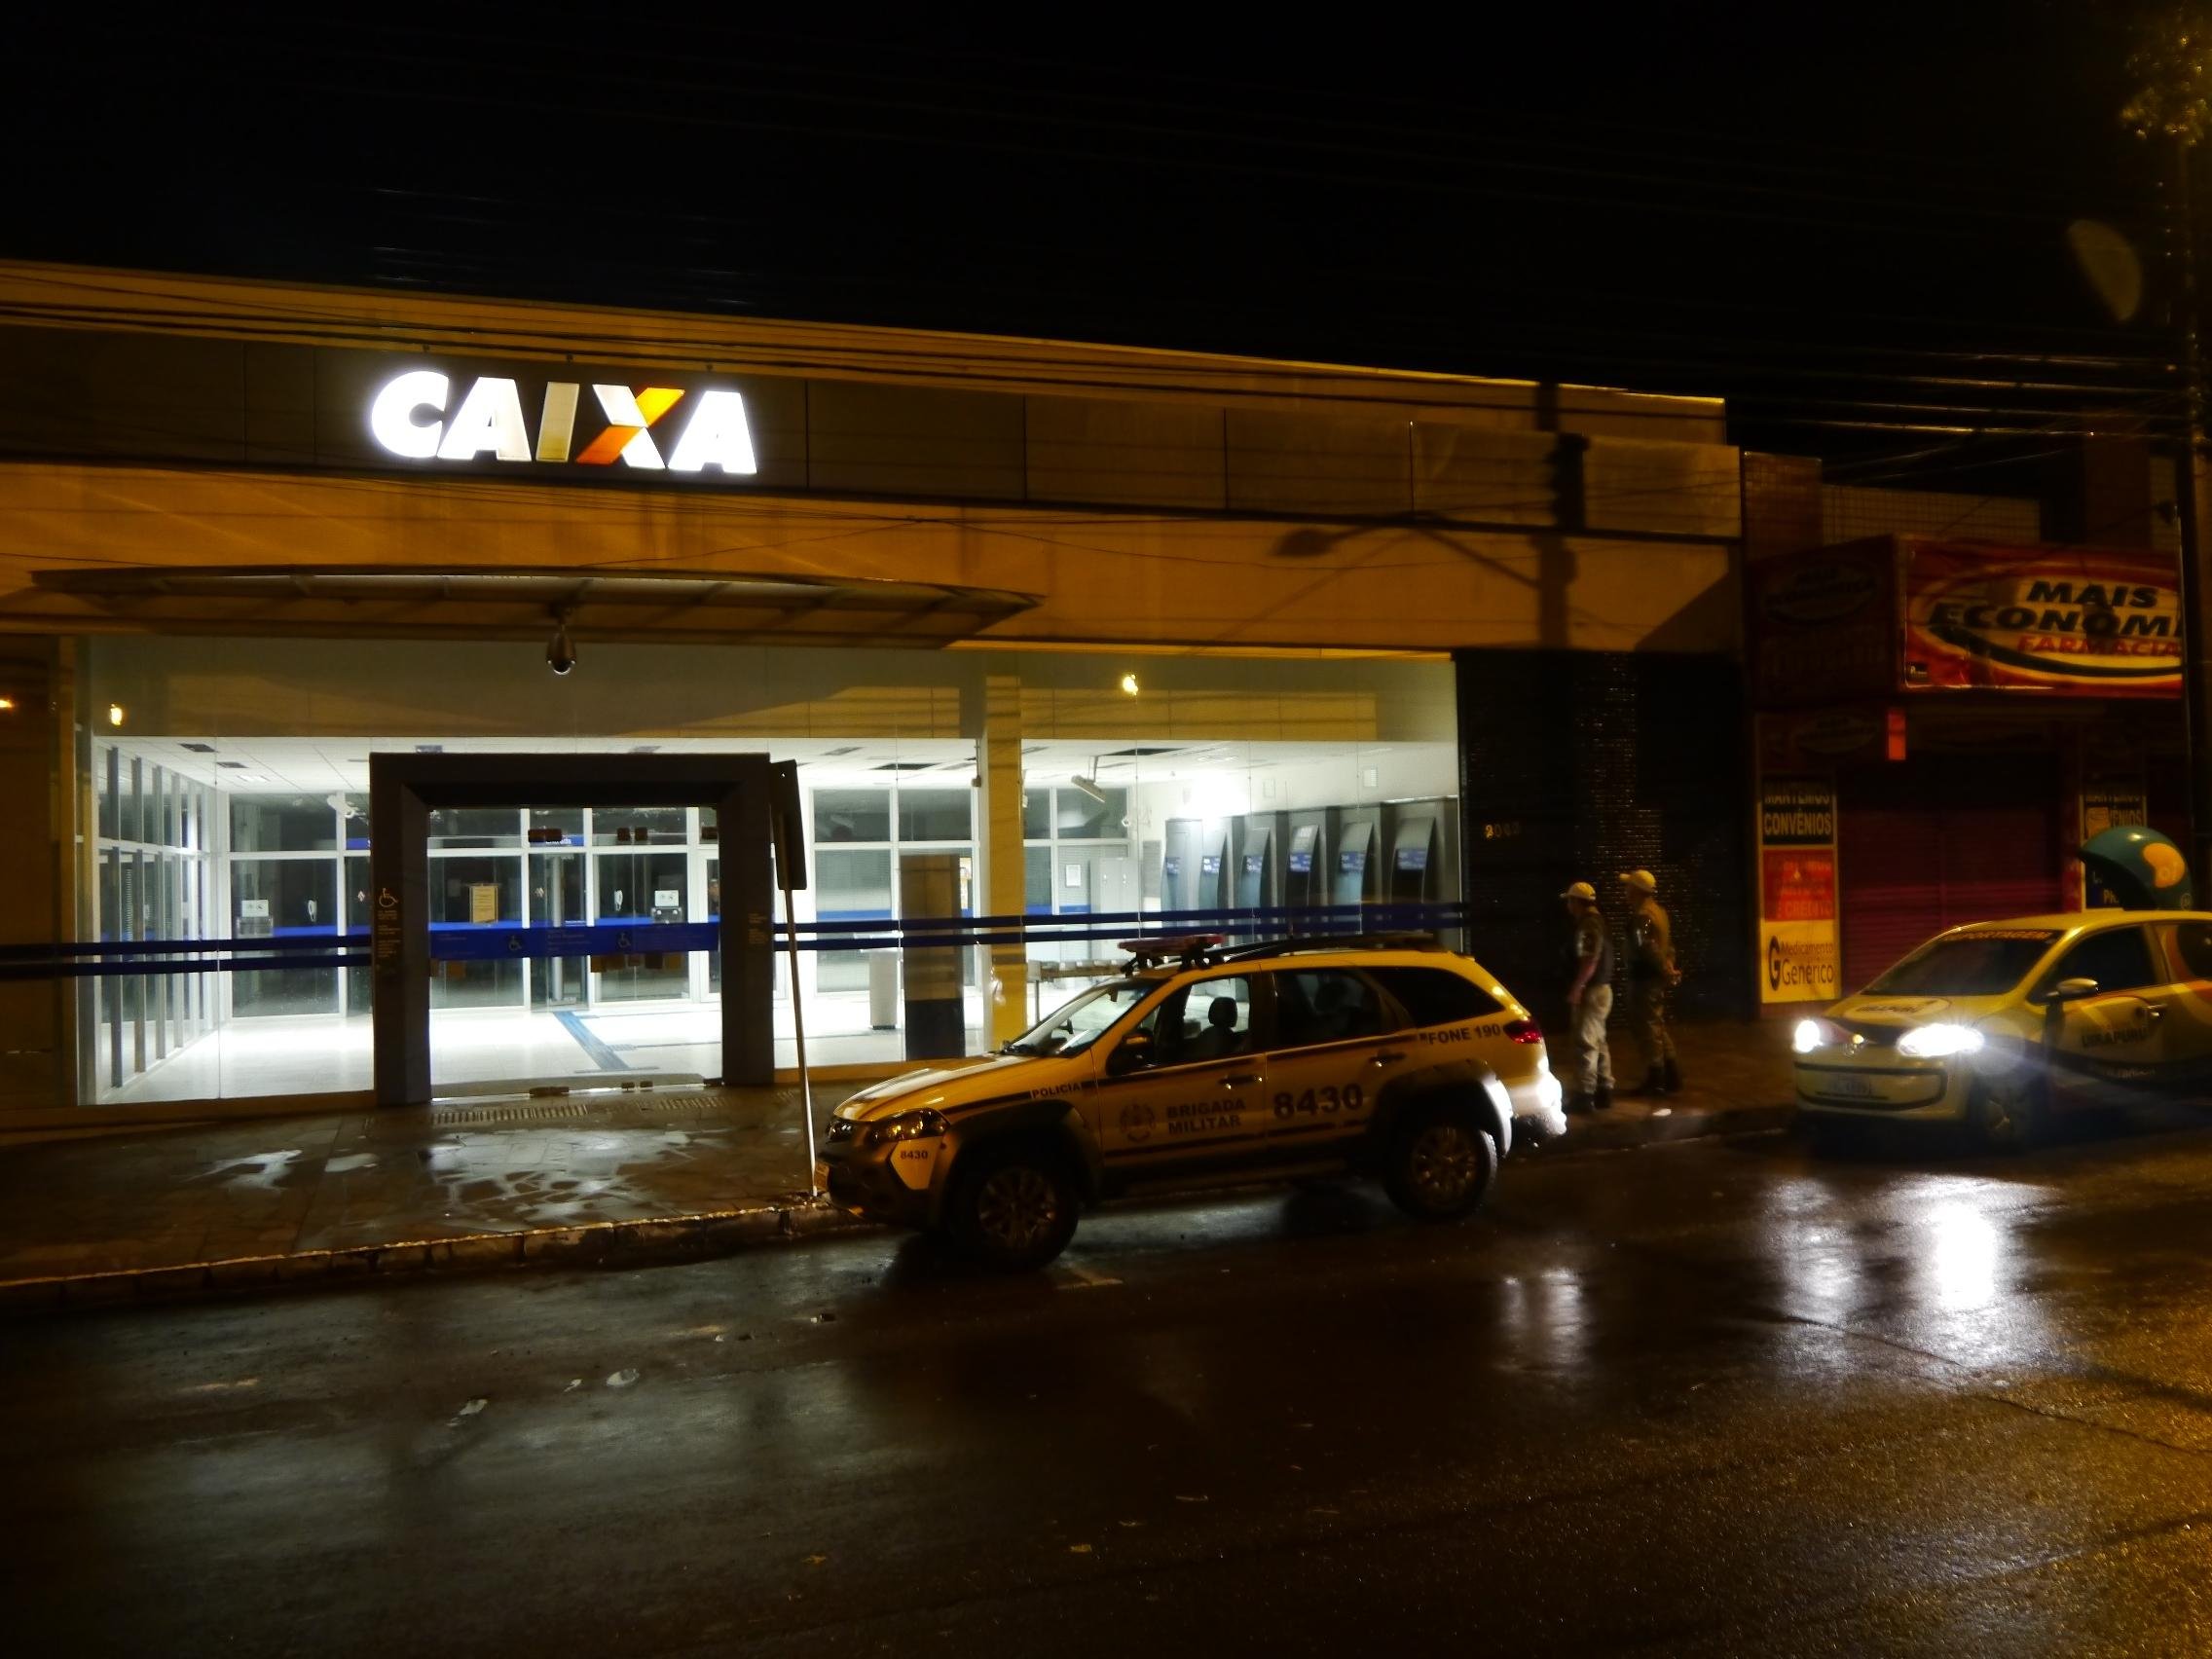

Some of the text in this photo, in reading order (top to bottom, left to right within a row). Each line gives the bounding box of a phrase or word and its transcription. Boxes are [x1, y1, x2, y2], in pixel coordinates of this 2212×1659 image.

[371, 371, 757, 474] CAIXA
[2027, 581, 2157, 608] MAIS
[1781, 941, 1834, 956] Medicamento
[1428, 1023, 1501, 1045] FONE 190
[1165, 1098, 1246, 1119] BRIGADA
[1273, 1083, 1363, 1120] 8430
[1168, 1114, 1242, 1134] MILITAR
[900, 1150, 929, 1161] 8430
